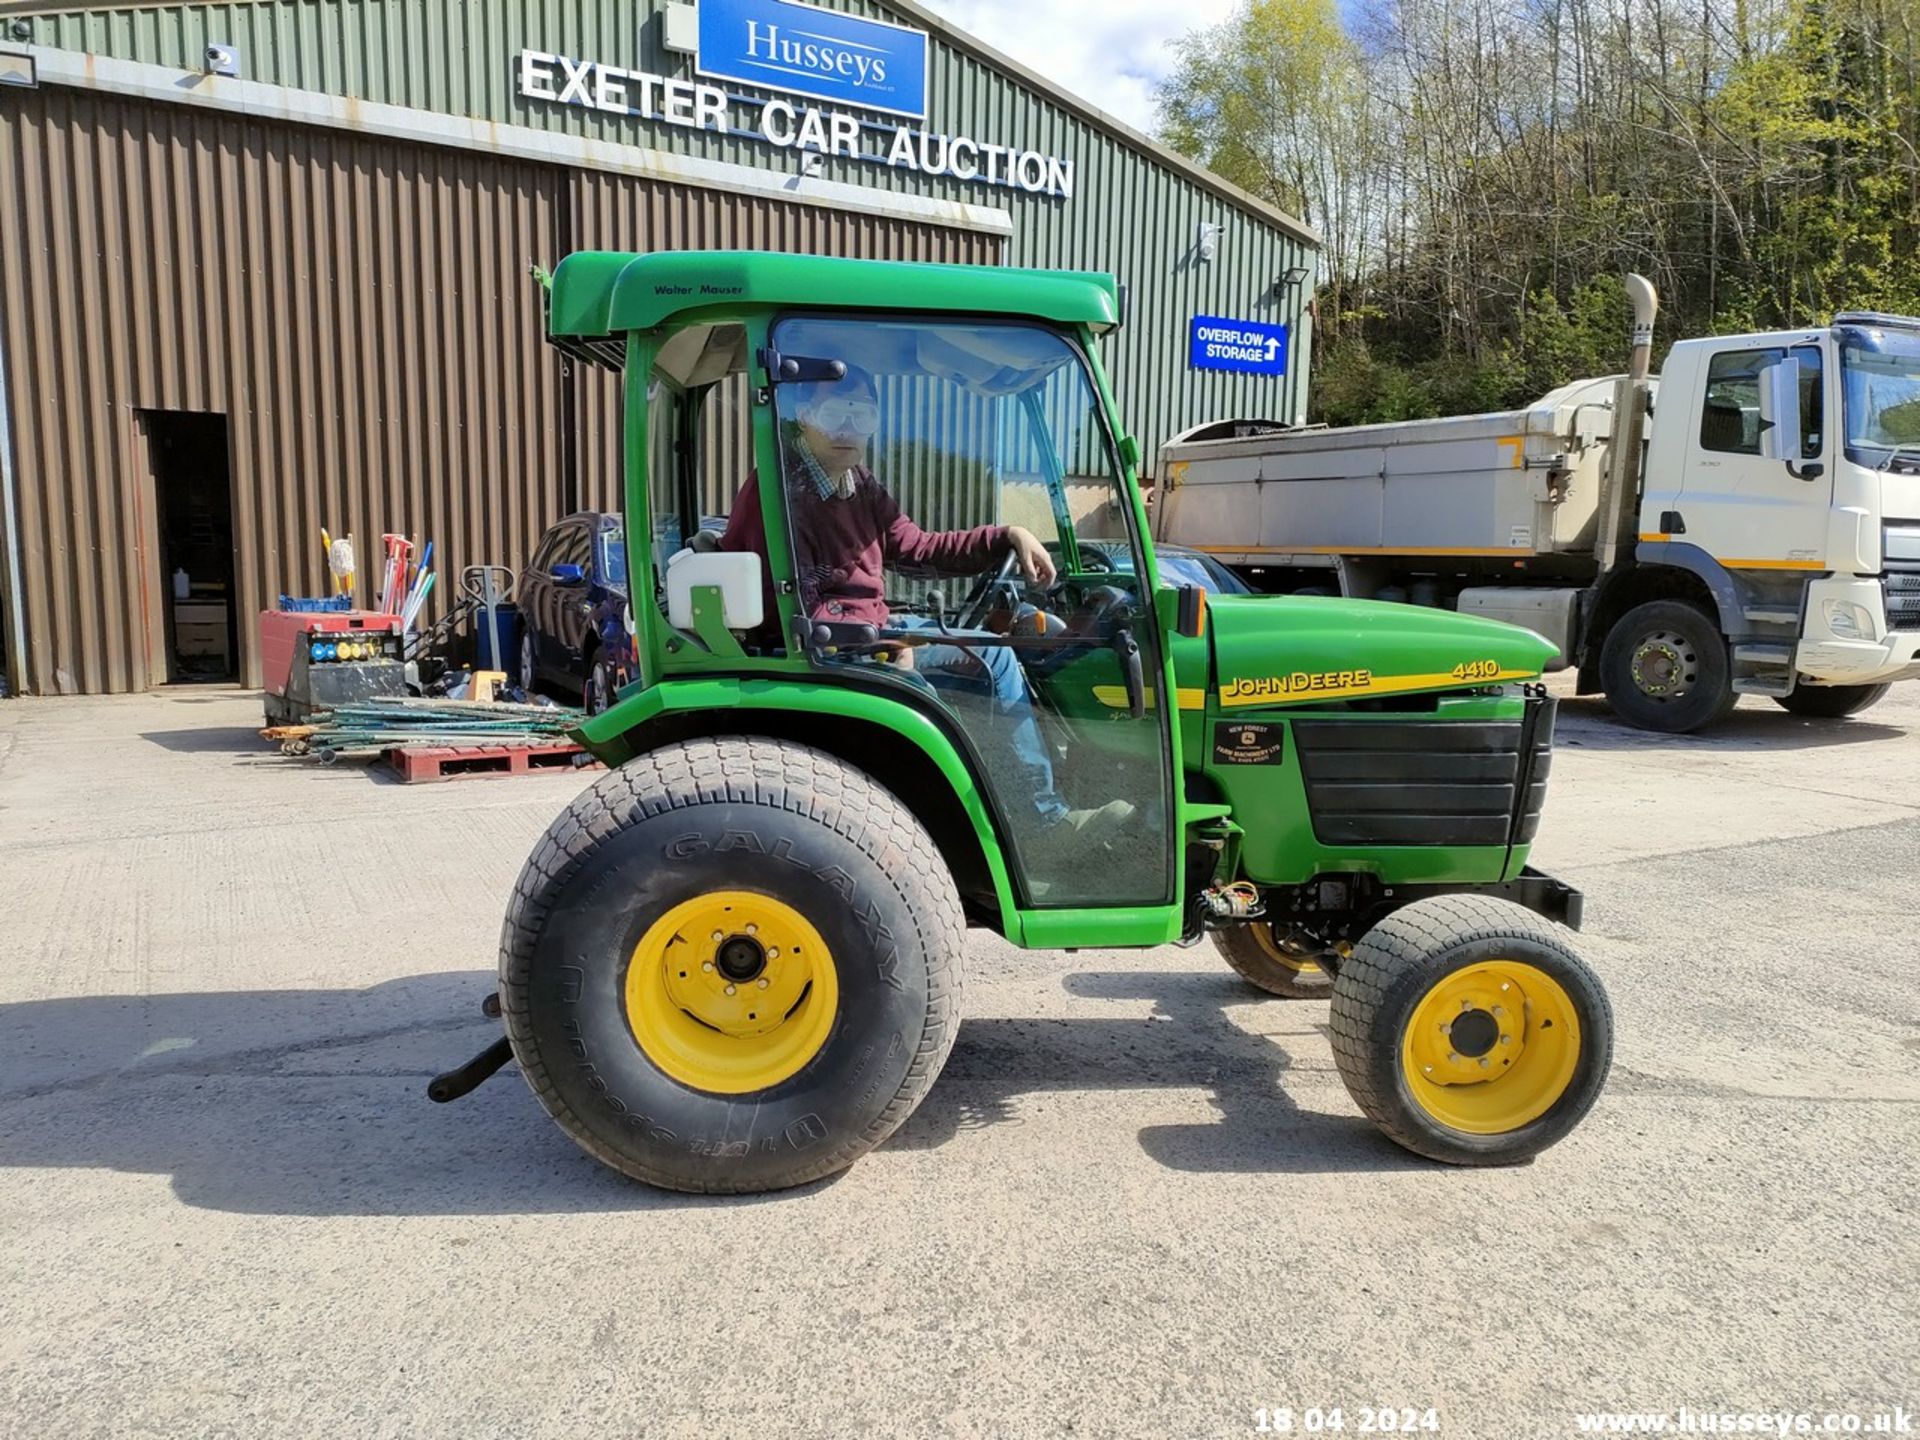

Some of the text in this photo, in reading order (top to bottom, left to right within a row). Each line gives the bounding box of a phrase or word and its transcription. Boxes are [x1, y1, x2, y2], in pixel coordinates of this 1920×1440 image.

[746, 20, 886, 86] Husseys
[522, 49, 1074, 198] EXETER CAR AUCTION
[654, 284, 743, 295] Walter Mauser
[1197, 327, 1264, 346] OVERFLOW
[1206, 344, 1263, 361] STORAGE
[1452, 659, 1499, 679] 4410
[664, 829, 904, 993] GALAXY
